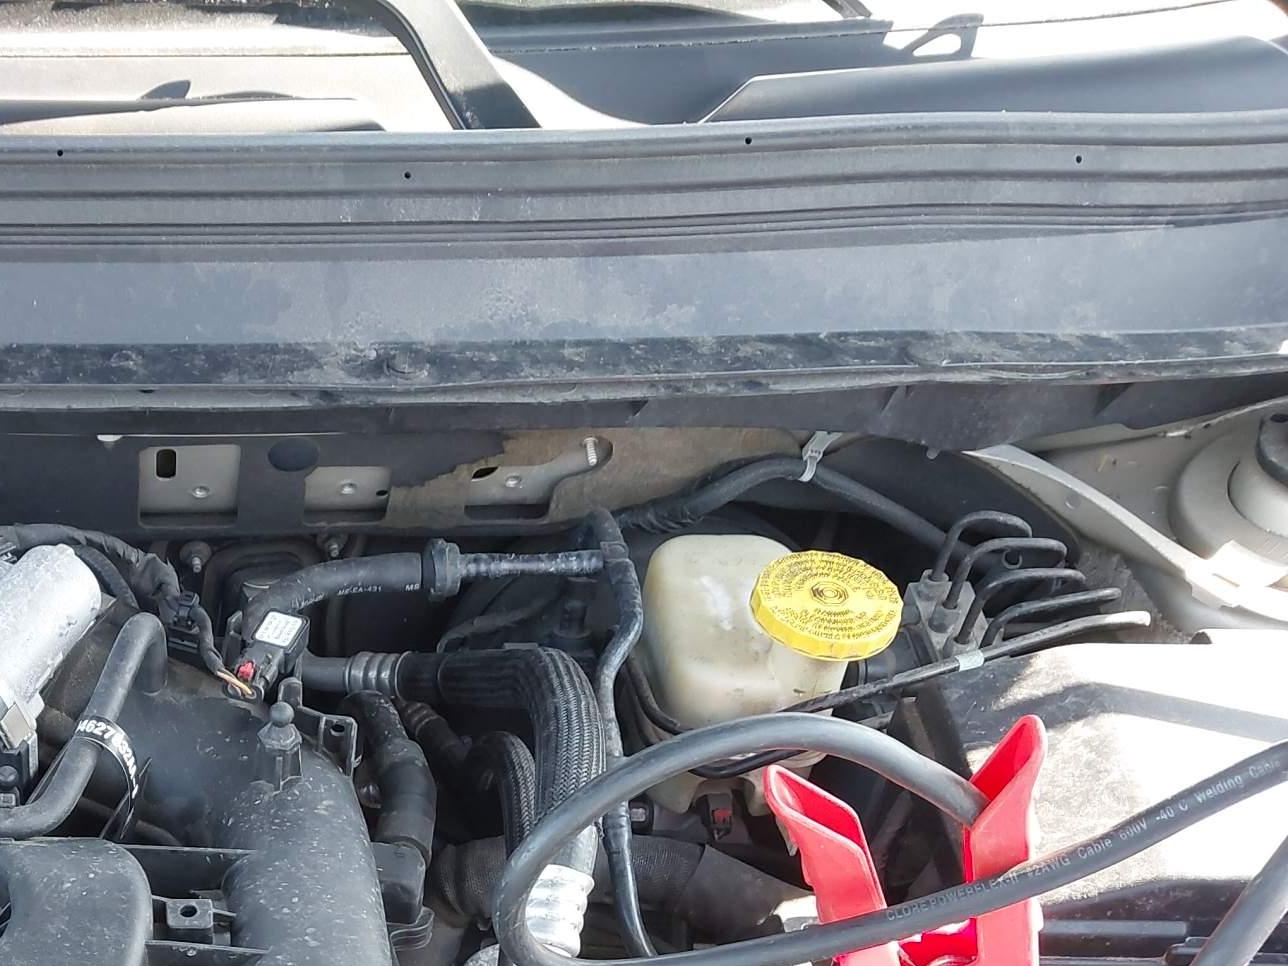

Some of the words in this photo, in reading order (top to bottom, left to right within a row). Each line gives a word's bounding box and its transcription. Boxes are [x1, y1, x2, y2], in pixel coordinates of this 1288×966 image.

[1077, 838, 1113, 860] Cable
[1120, 819, 1148, 841] 600V
[1194, 774, 1245, 804] Welding
